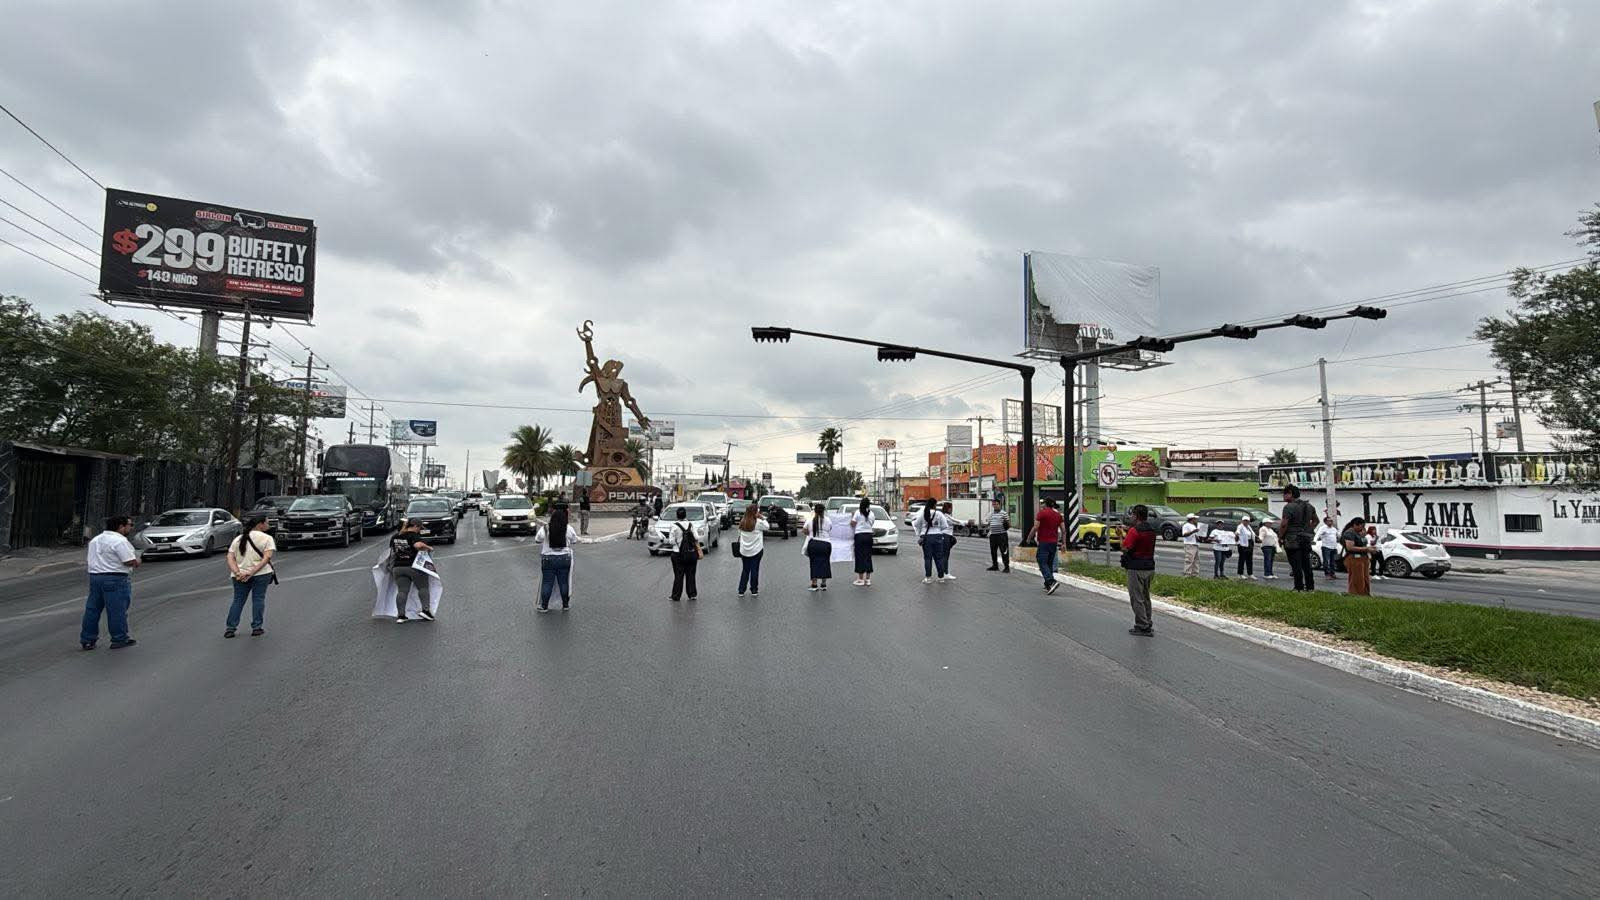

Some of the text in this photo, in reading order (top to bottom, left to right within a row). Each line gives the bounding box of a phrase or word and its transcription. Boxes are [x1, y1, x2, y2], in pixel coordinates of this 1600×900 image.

[195, 210, 232, 223] SIRLOIN
[112, 223, 226, 273] $299
[227, 235, 307, 265] BUFFET Y
[172, 272, 198, 286] NIÑOS
[227, 256, 305, 283] REFRESCO
[1361, 492, 1478, 528] LA YAMA
[1568, 499, 1600, 518] YAM
[1422, 526, 1479, 540] DRIVE THRU
